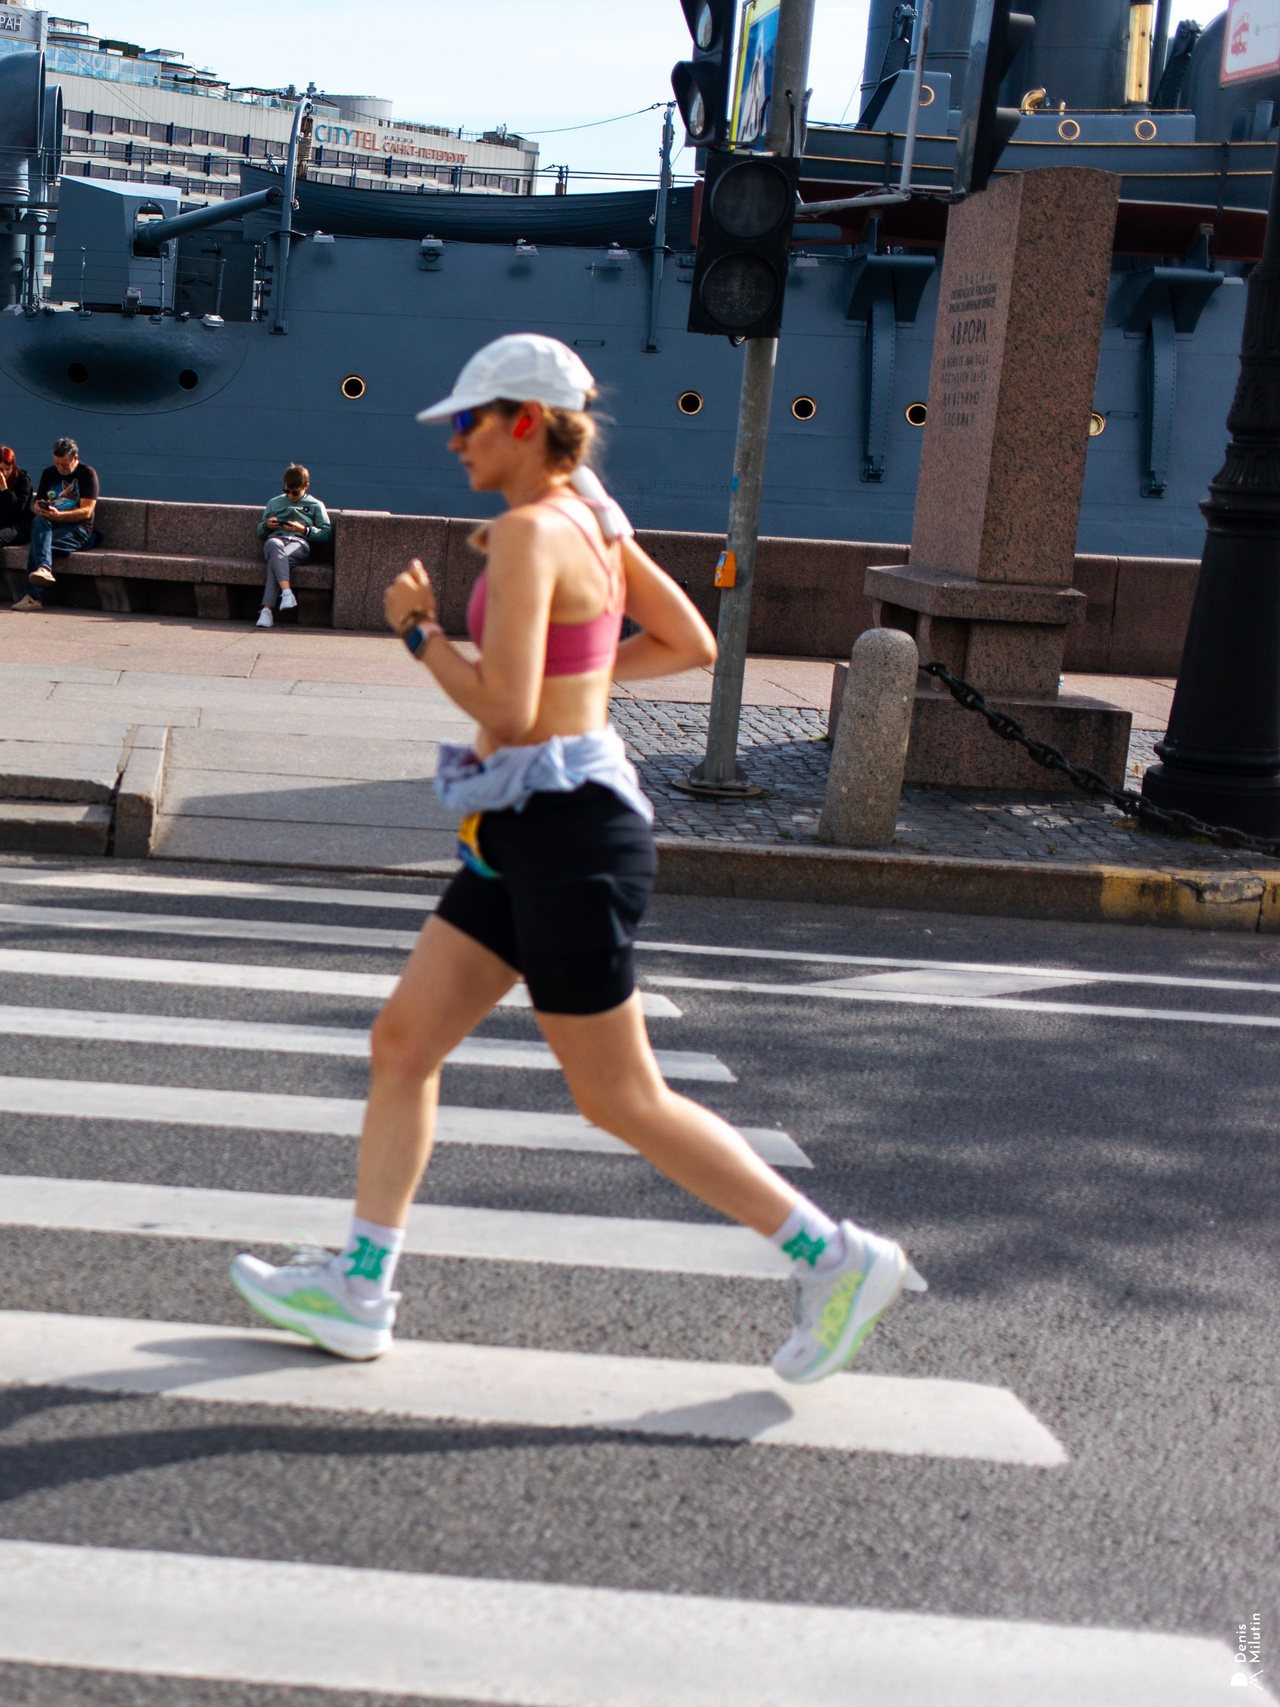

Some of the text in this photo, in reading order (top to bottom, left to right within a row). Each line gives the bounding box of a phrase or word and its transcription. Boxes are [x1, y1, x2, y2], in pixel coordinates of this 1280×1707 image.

[315, 123, 380, 151] CITYTEL
[383, 141, 469, 164] САНКТ-ПЕТЕРБУРГ
[951, 319, 987, 346] АВРОРА
[812, 1271, 864, 1350] HOKA
